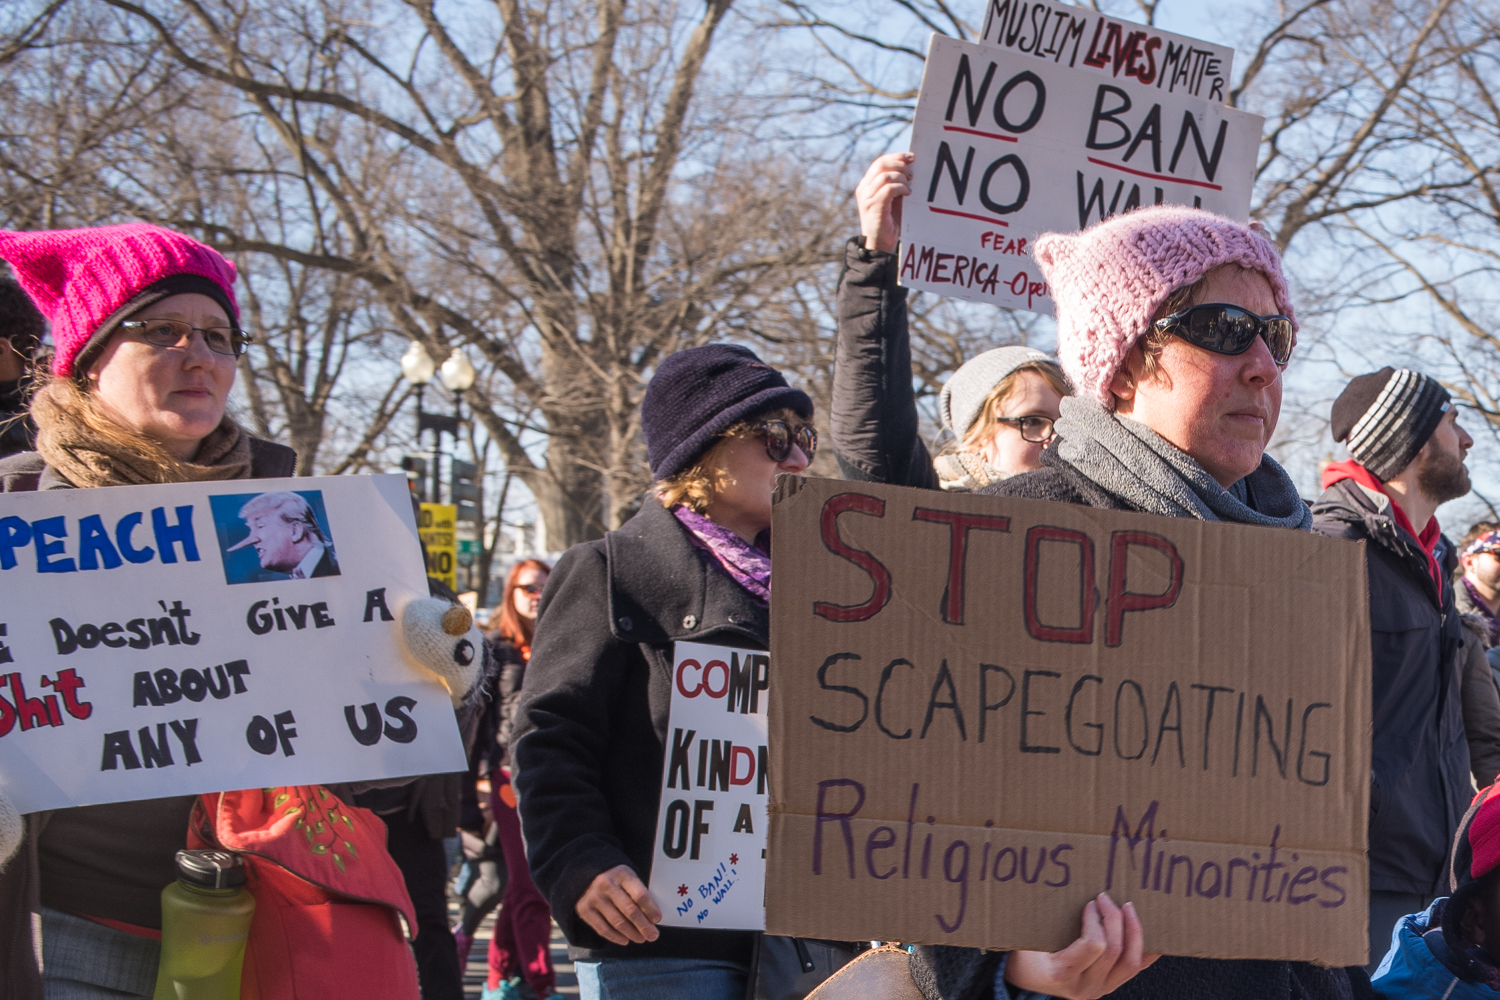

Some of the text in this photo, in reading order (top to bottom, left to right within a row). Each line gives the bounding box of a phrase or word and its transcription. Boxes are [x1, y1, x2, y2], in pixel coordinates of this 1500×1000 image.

[983, 0, 1087, 68] MUSLIM
[1084, 16, 1162, 85] LIVES
[945, 53, 1228, 182] NO BAN
[927, 141, 1030, 214] NO
[981, 231, 1028, 257] FEAR
[363, 587, 395, 623] A
[812, 491, 1186, 649] STOP
[132, 659, 251, 708] ABOUT
[809, 652, 1333, 787] SCAPEGOATING
[101, 696, 418, 772] ANY OF US
[662, 799, 754, 860] OF A
[811, 778, 1350, 935] Religious Minorities
[676, 862, 728, 917] NO BAN!
[697, 868, 740, 924] NO WALL!
